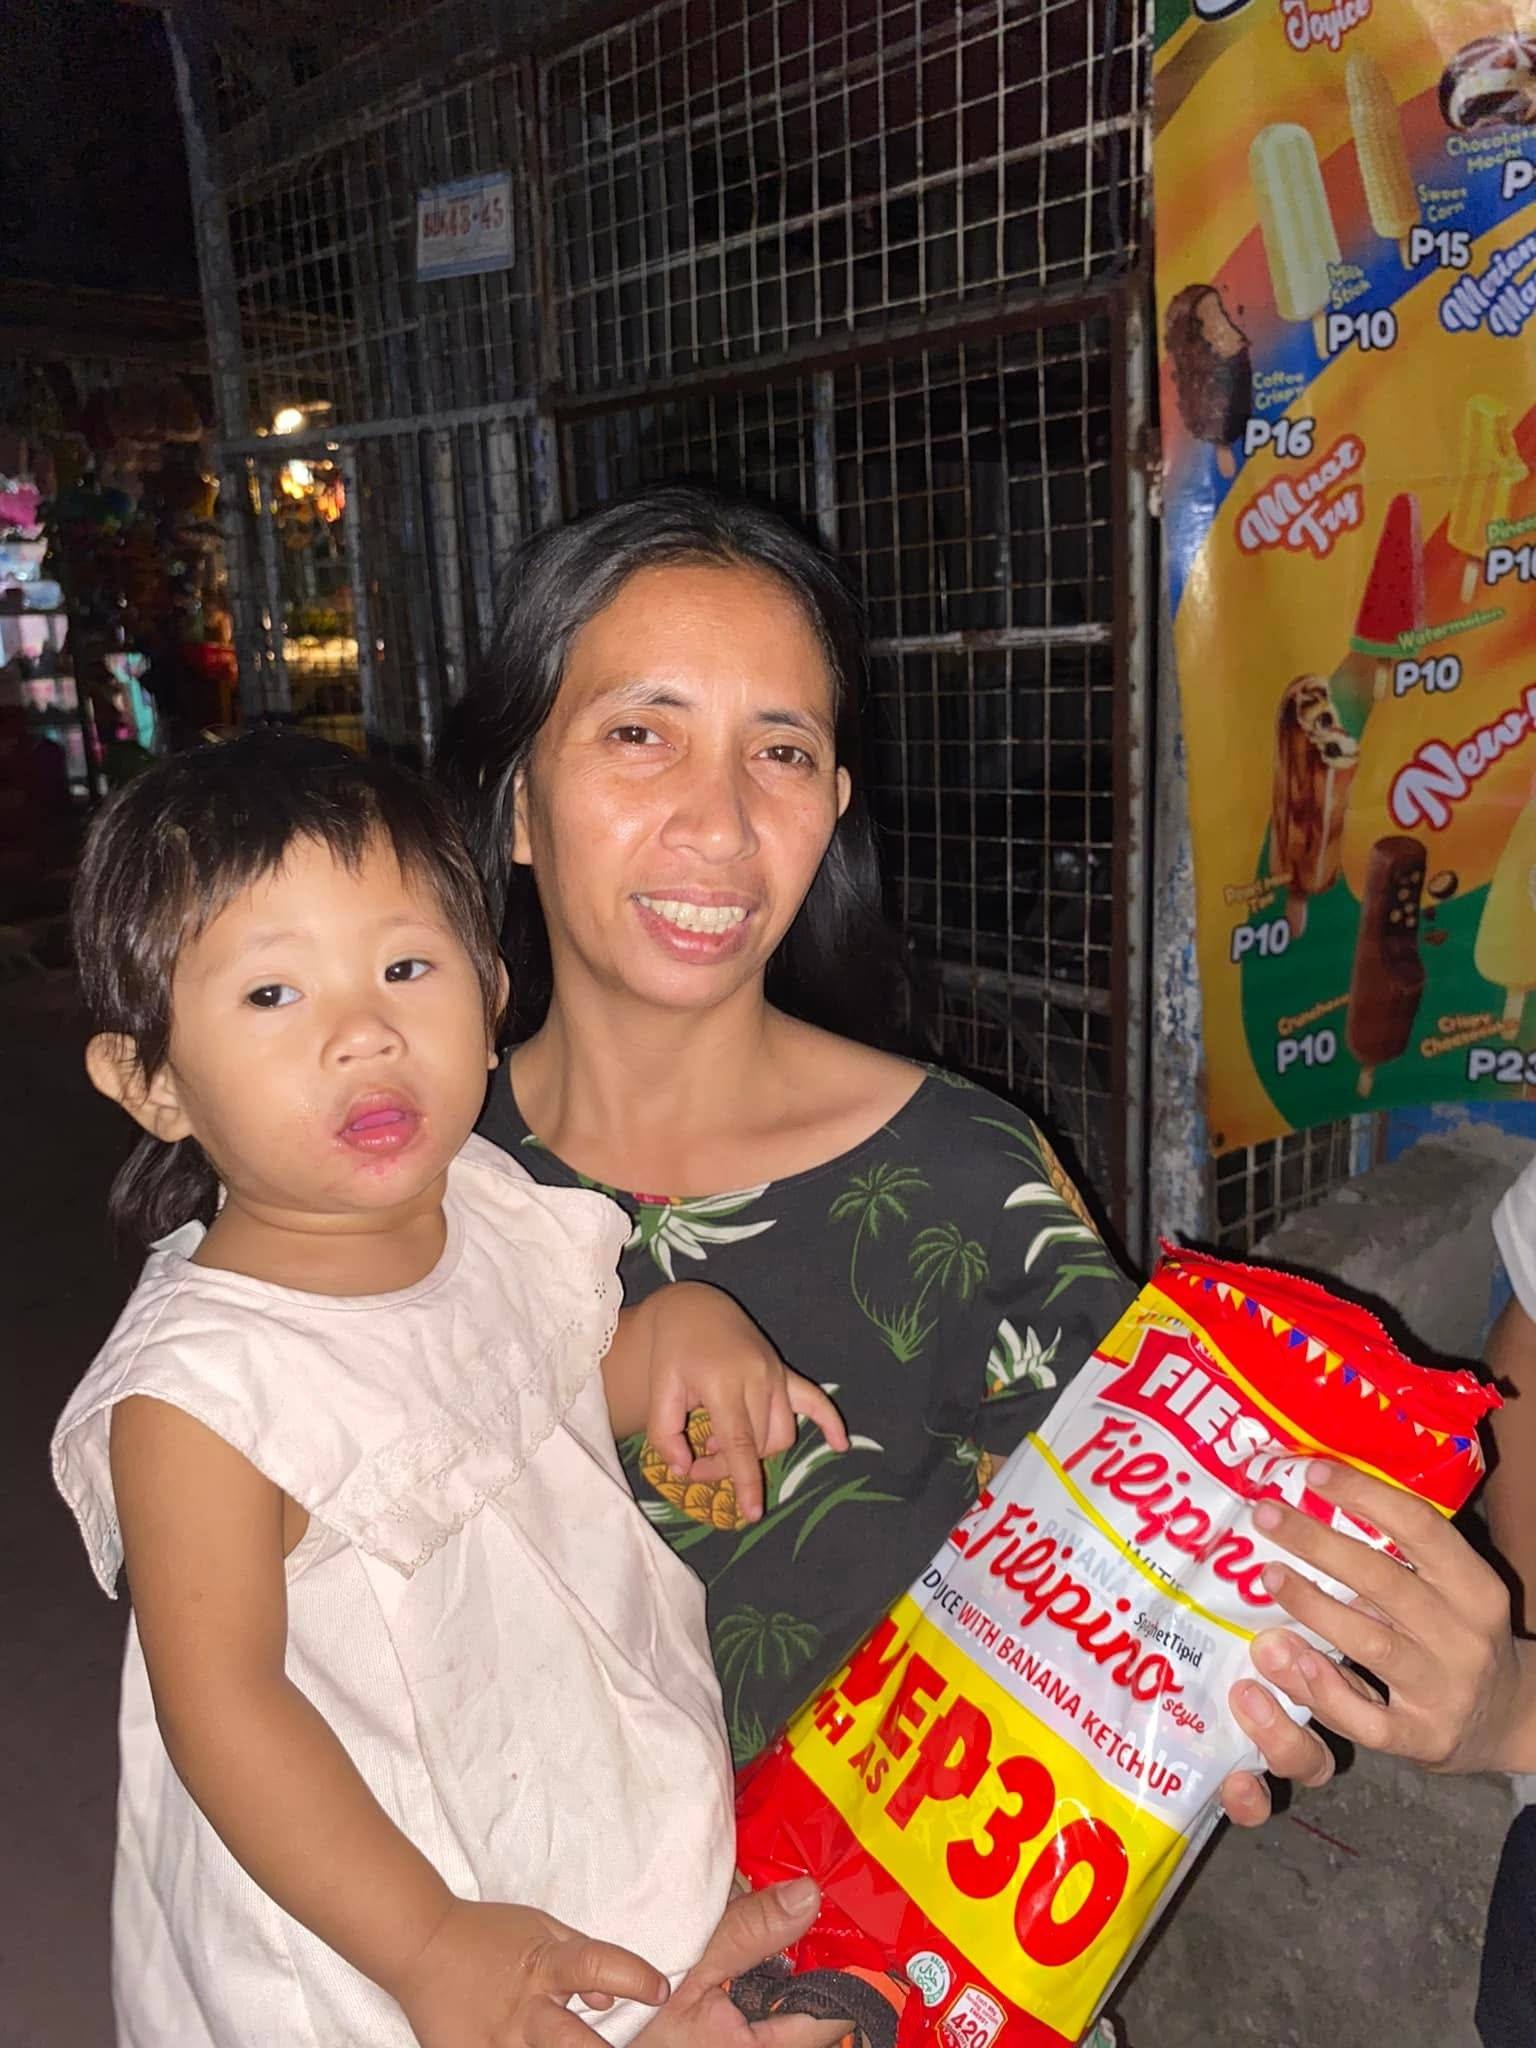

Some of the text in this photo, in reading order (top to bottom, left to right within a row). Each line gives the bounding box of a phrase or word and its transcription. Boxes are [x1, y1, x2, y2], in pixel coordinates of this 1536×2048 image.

[1502, 159, 1536, 200] P
[1410, 227, 1471, 269] P15
[1327, 309, 1397, 353] P10
[1251, 371, 1304, 390] Coffee
[1244, 418, 1314, 457] P16
[1238, 437, 1362, 550] Must
[1286, 488, 1362, 554] Try
[1398, 608, 1504, 650] Watermelon
[1395, 657, 1461, 697] P10
[1231, 919, 1290, 963] P10
[1277, 1029, 1336, 1073] P10
[964, 1502, 1184, 1703] Filipino
[923, 1565, 963, 1616] DUCE
[956, 1601, 1001, 1657] WITH
[995, 1638, 1081, 1719] BANANA
[1081, 1709, 1183, 1797] KETCHUP
[1162, 1697, 1206, 1735] style
[812, 1687, 890, 1795] H AS
[884, 1695, 1129, 1967] P30
[950, 2012, 989, 2048] 420
